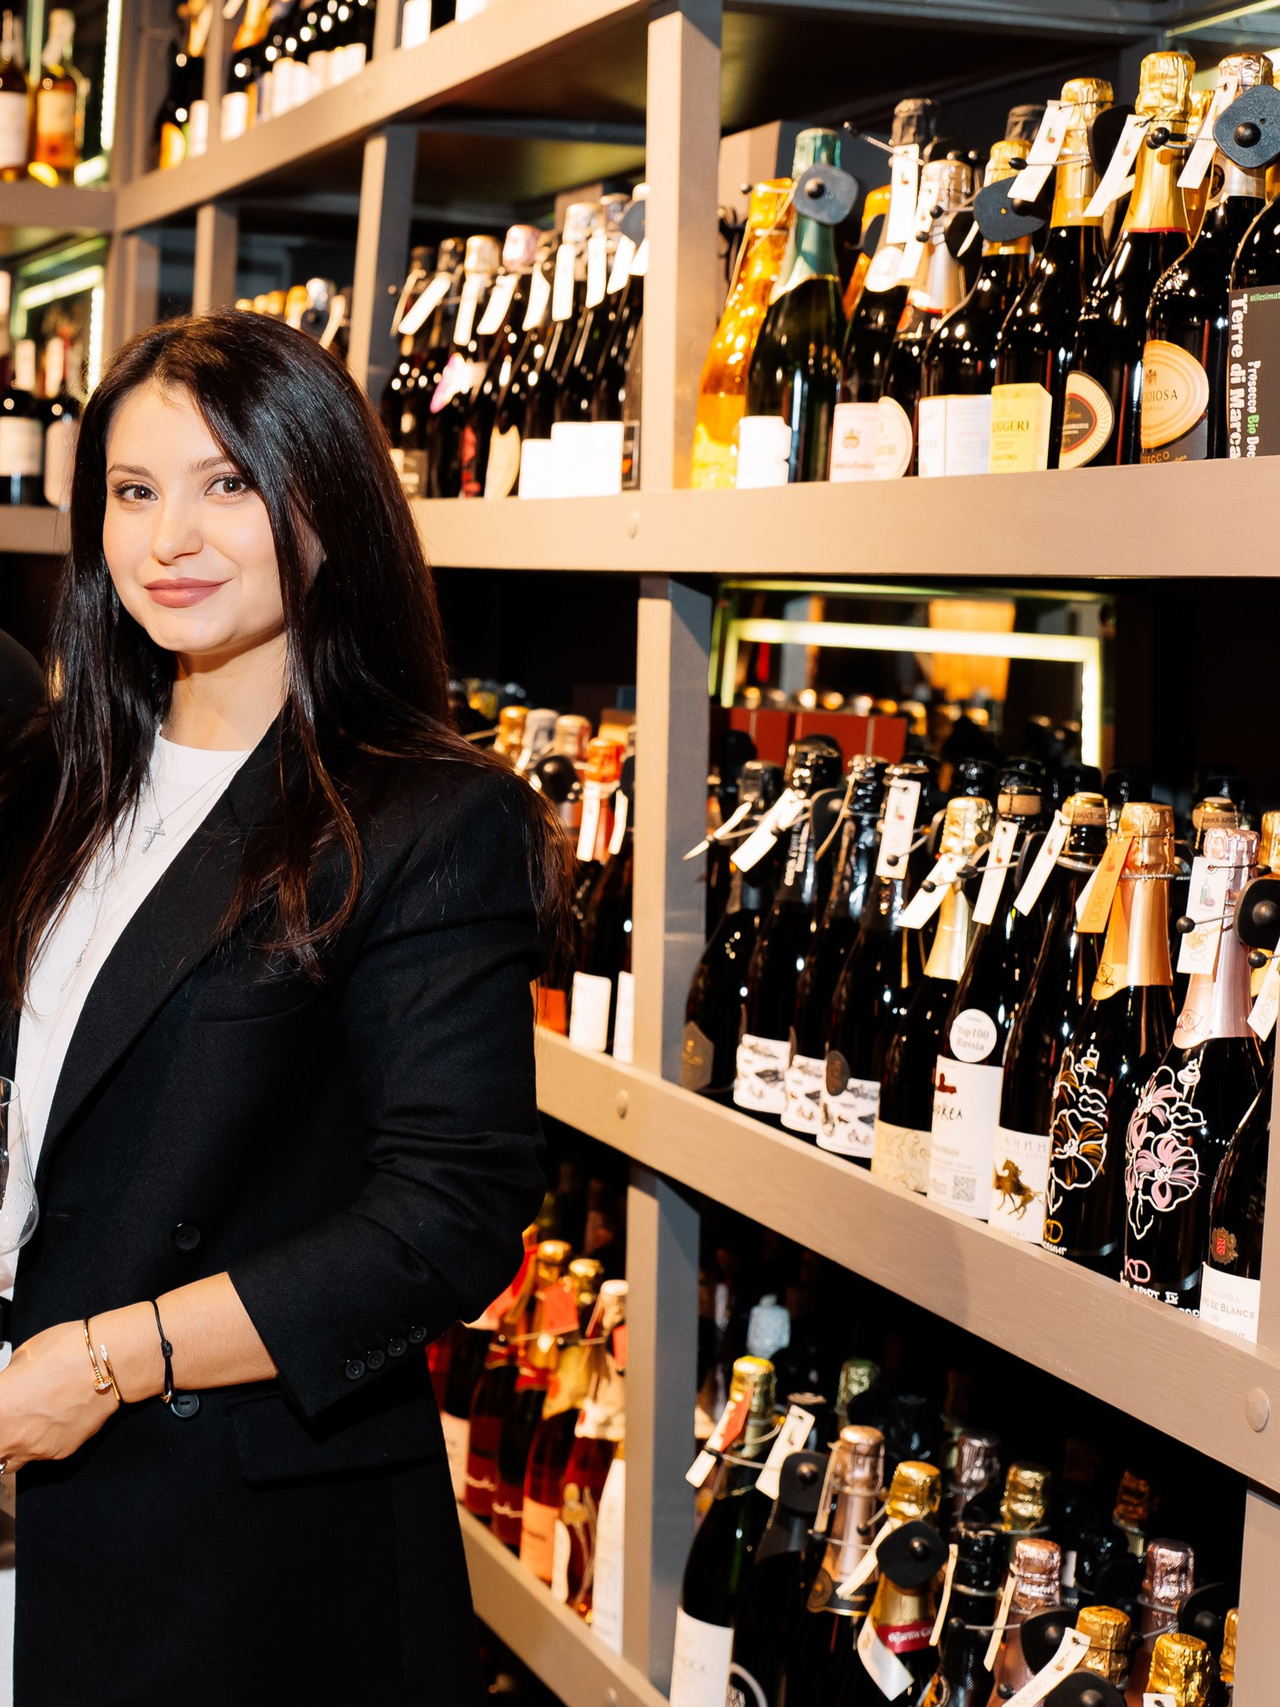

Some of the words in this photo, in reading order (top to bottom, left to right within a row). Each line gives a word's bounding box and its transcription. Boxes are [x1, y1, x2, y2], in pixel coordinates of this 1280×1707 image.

[1231, 293, 1248, 358] Terre
[1230, 363, 1247, 384] di
[1247, 360, 1261, 413] Prosecco
[1229, 388, 1245, 459] Marca
[1247, 415, 1260, 434] Bio
[1246, 436, 1260, 458] Doc
[1087, 888, 1108, 923] 3800
